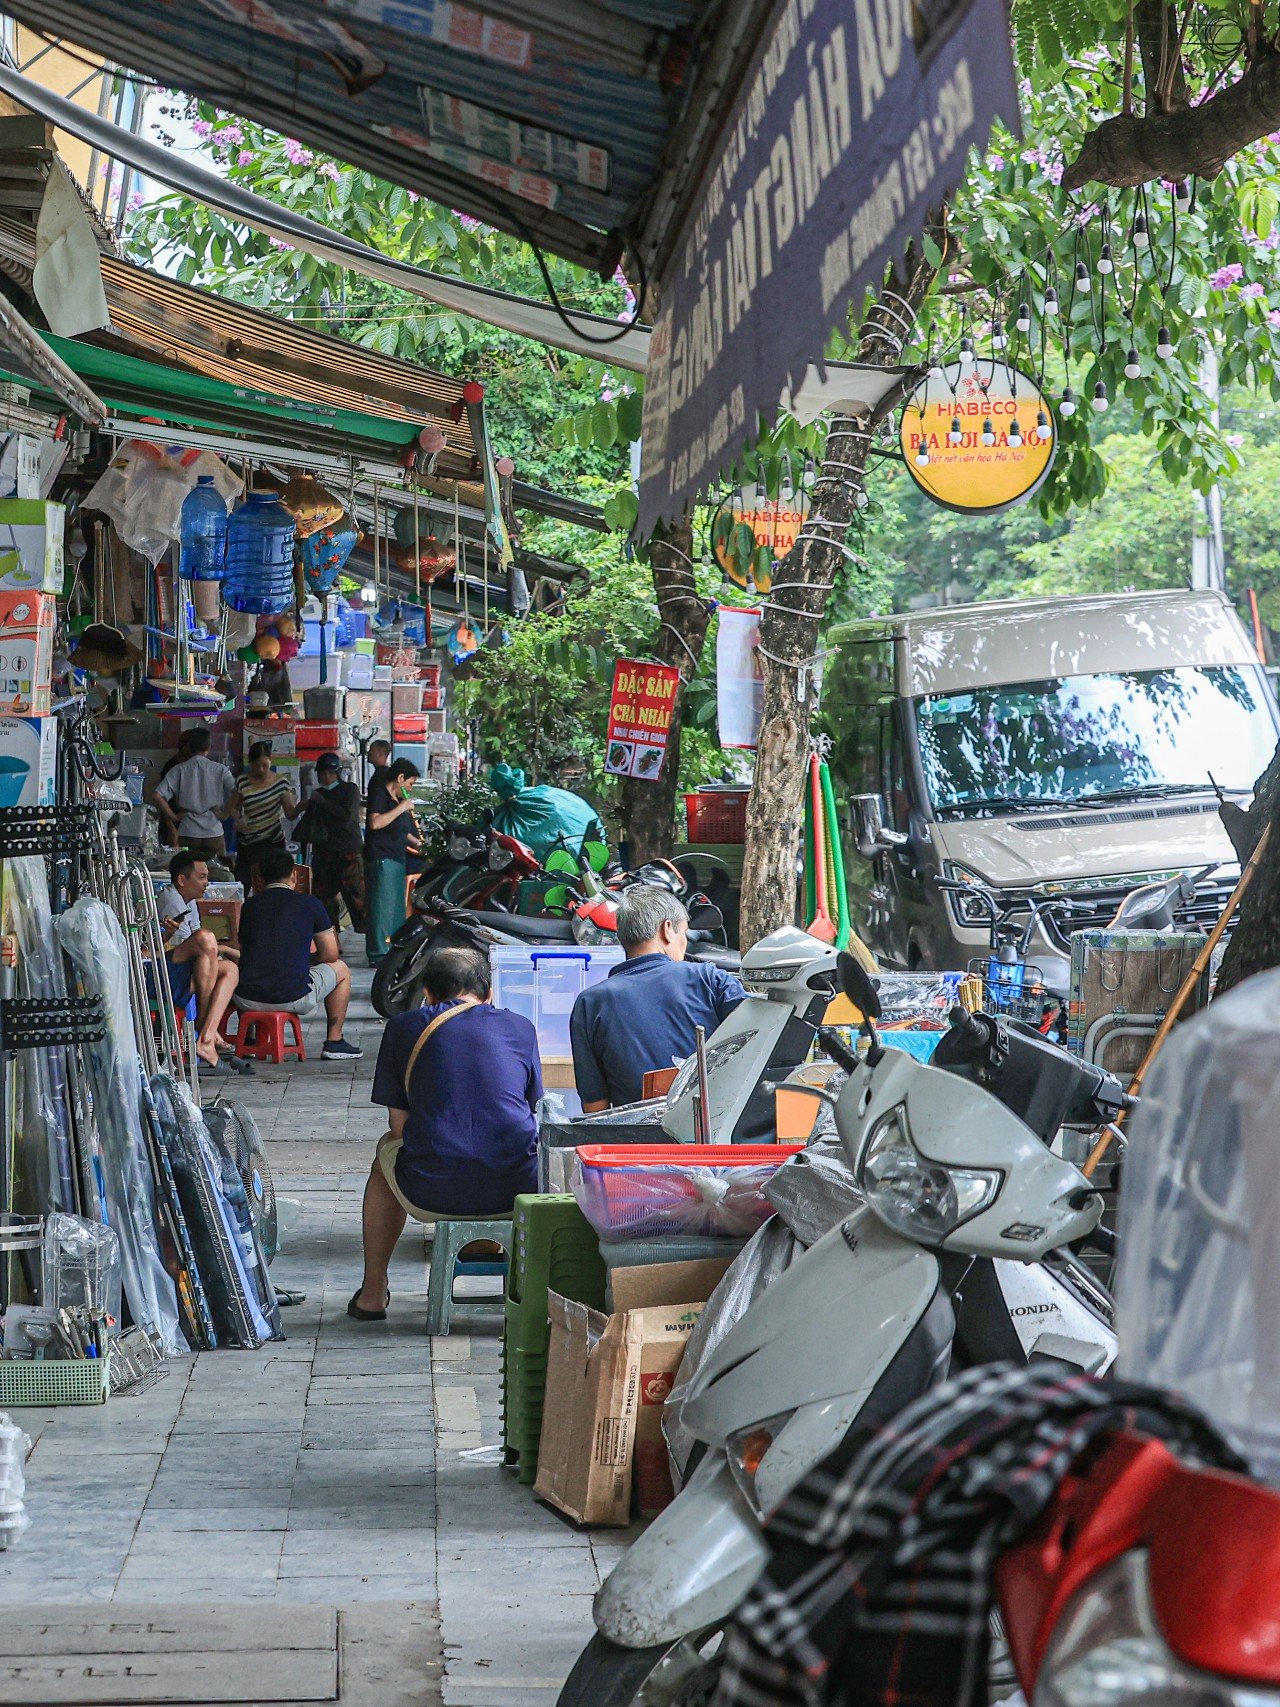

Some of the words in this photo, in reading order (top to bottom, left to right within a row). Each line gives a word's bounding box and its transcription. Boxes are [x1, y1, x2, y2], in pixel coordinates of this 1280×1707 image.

[938, 402, 1018, 416] HABECO
[740, 512, 802, 522] HABECO
[617, 669, 644, 698] ĐẶC
[646, 670, 674, 699] SẢN
[613, 698, 636, 724] CHẢ
[638, 705, 670, 728] NHÁI
